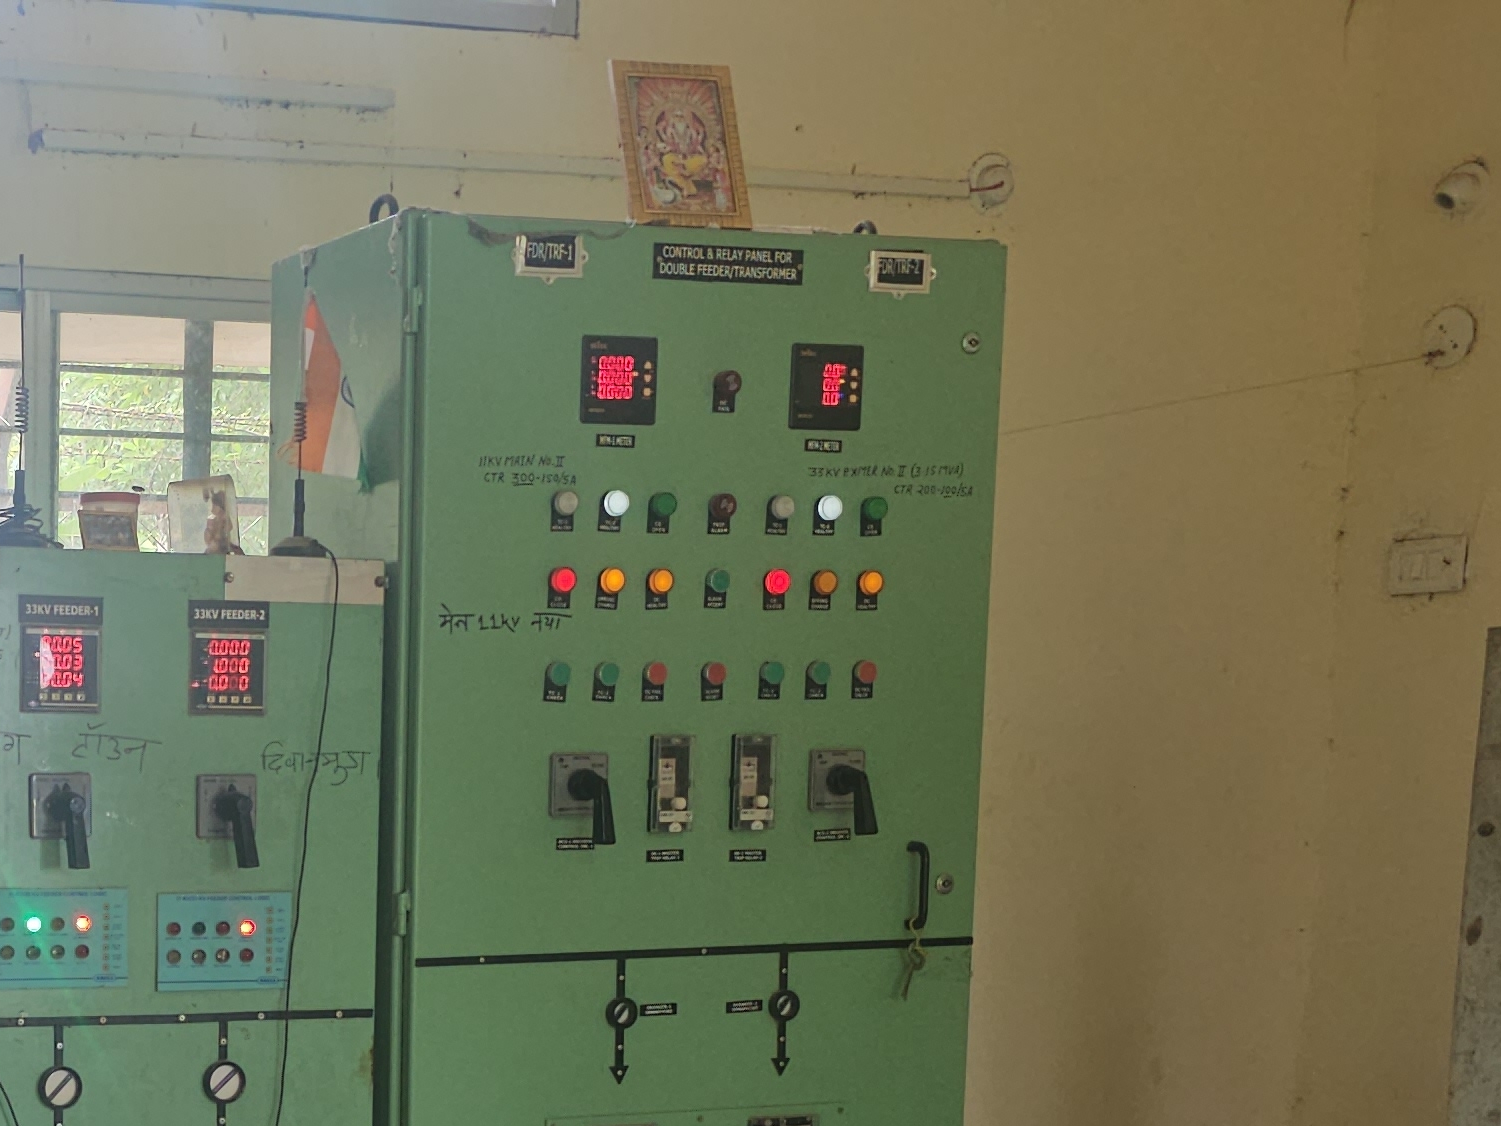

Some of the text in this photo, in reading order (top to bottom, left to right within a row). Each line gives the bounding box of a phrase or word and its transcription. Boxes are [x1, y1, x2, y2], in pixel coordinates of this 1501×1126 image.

[526, 241, 573, 261] FDR/TRF-1
[662, 246, 793, 264] CONTROL & RELAY PANEL FOR
[659, 262, 797, 280] DOUBLE FEEDER/TRANSFORMER
[878, 258, 920, 275] FDR/TRF-2
[504, 454, 535, 467] MAIN
[484, 472, 505, 484] CTR
[893, 484, 913, 495] CTR
[25, 603, 99, 616] 33KV FEEDER-1
[194, 608, 265, 620] 33KV FEEDER-2
[437, 602, 475, 634] मेन
[530, 611, 572, 633] नया
